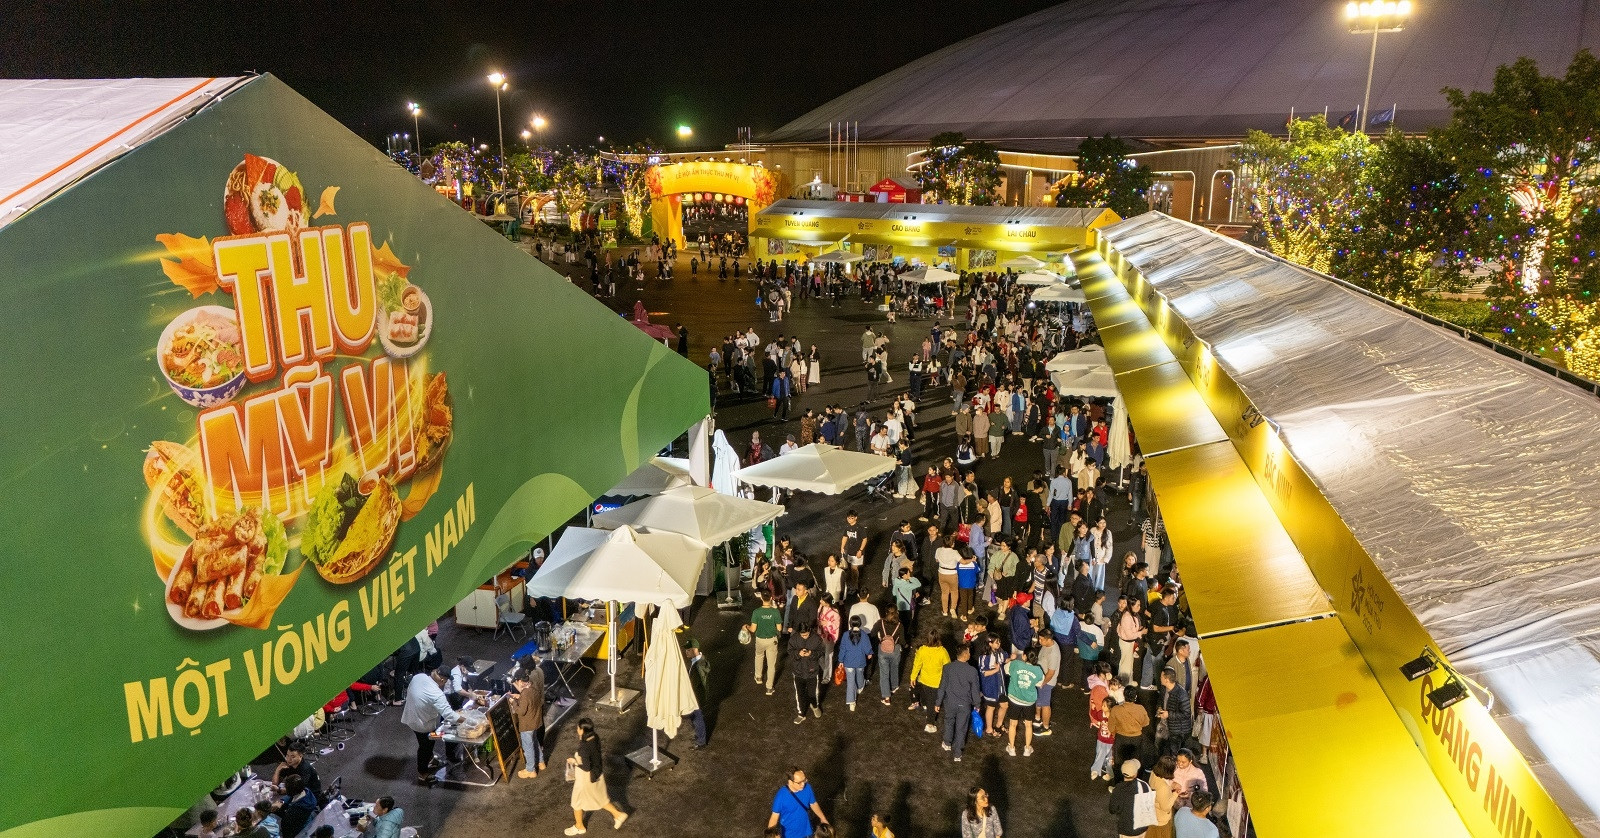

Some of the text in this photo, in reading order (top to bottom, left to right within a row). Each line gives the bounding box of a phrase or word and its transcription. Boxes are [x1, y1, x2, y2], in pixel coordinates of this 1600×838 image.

[213, 222, 378, 381] THU
[199, 361, 333, 519] MỸ
[124, 482, 476, 743] MỘT VÒNG VIỆT NAM
